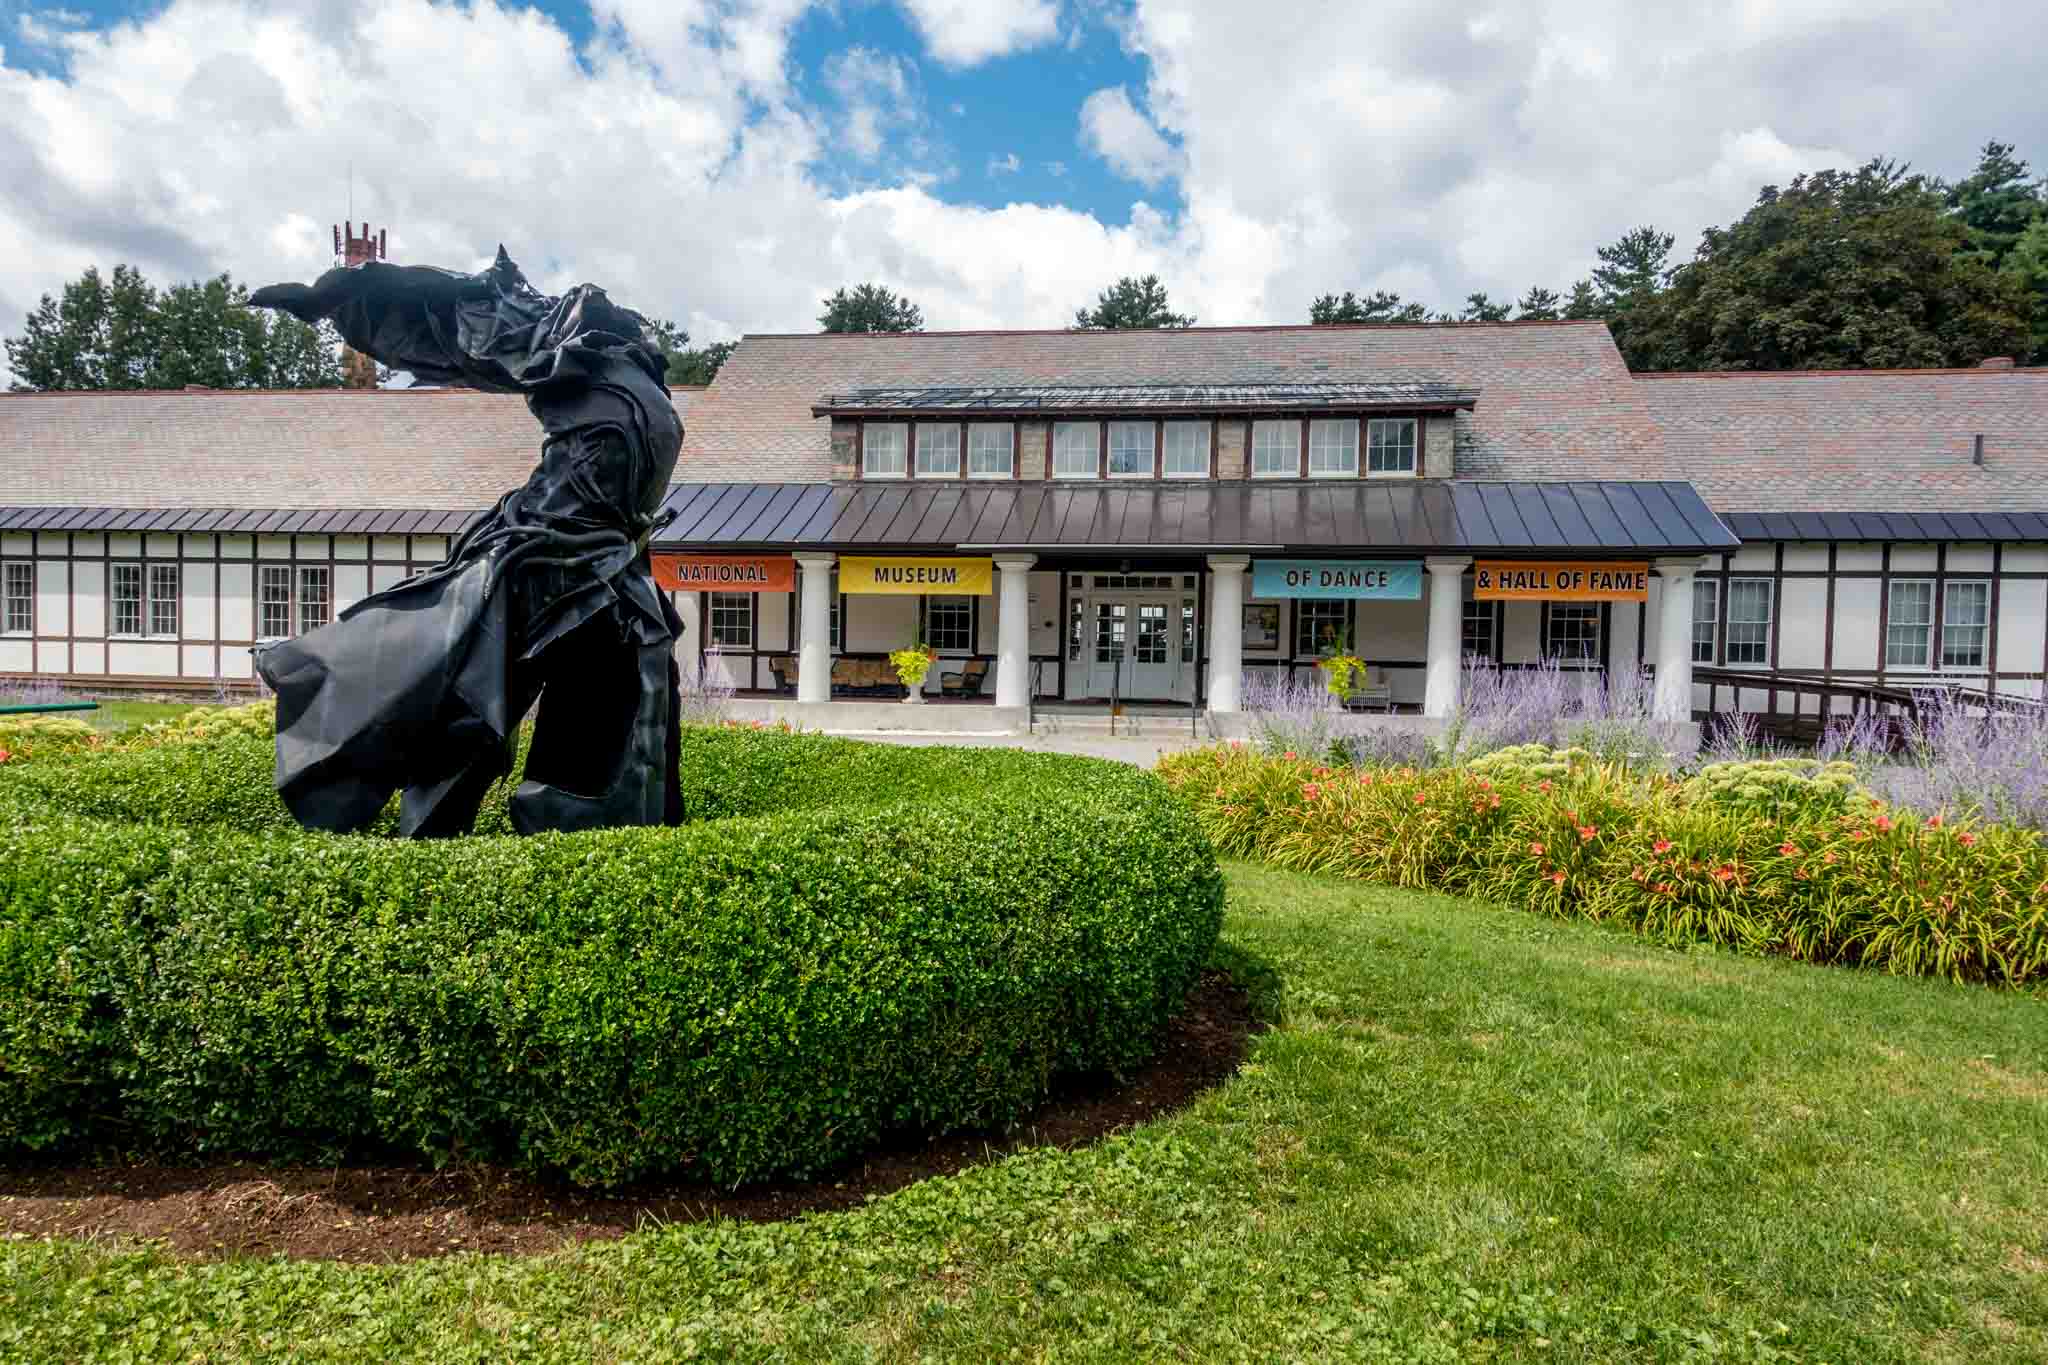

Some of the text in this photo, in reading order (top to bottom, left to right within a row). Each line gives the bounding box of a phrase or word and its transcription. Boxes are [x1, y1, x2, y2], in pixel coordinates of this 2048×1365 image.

[677, 563, 768, 582] NATIONAL
[874, 567, 957, 584] MUSEUM
[1286, 570, 1388, 587] OF DANCE
[1477, 570, 1647, 591] & HALL OF FAME
